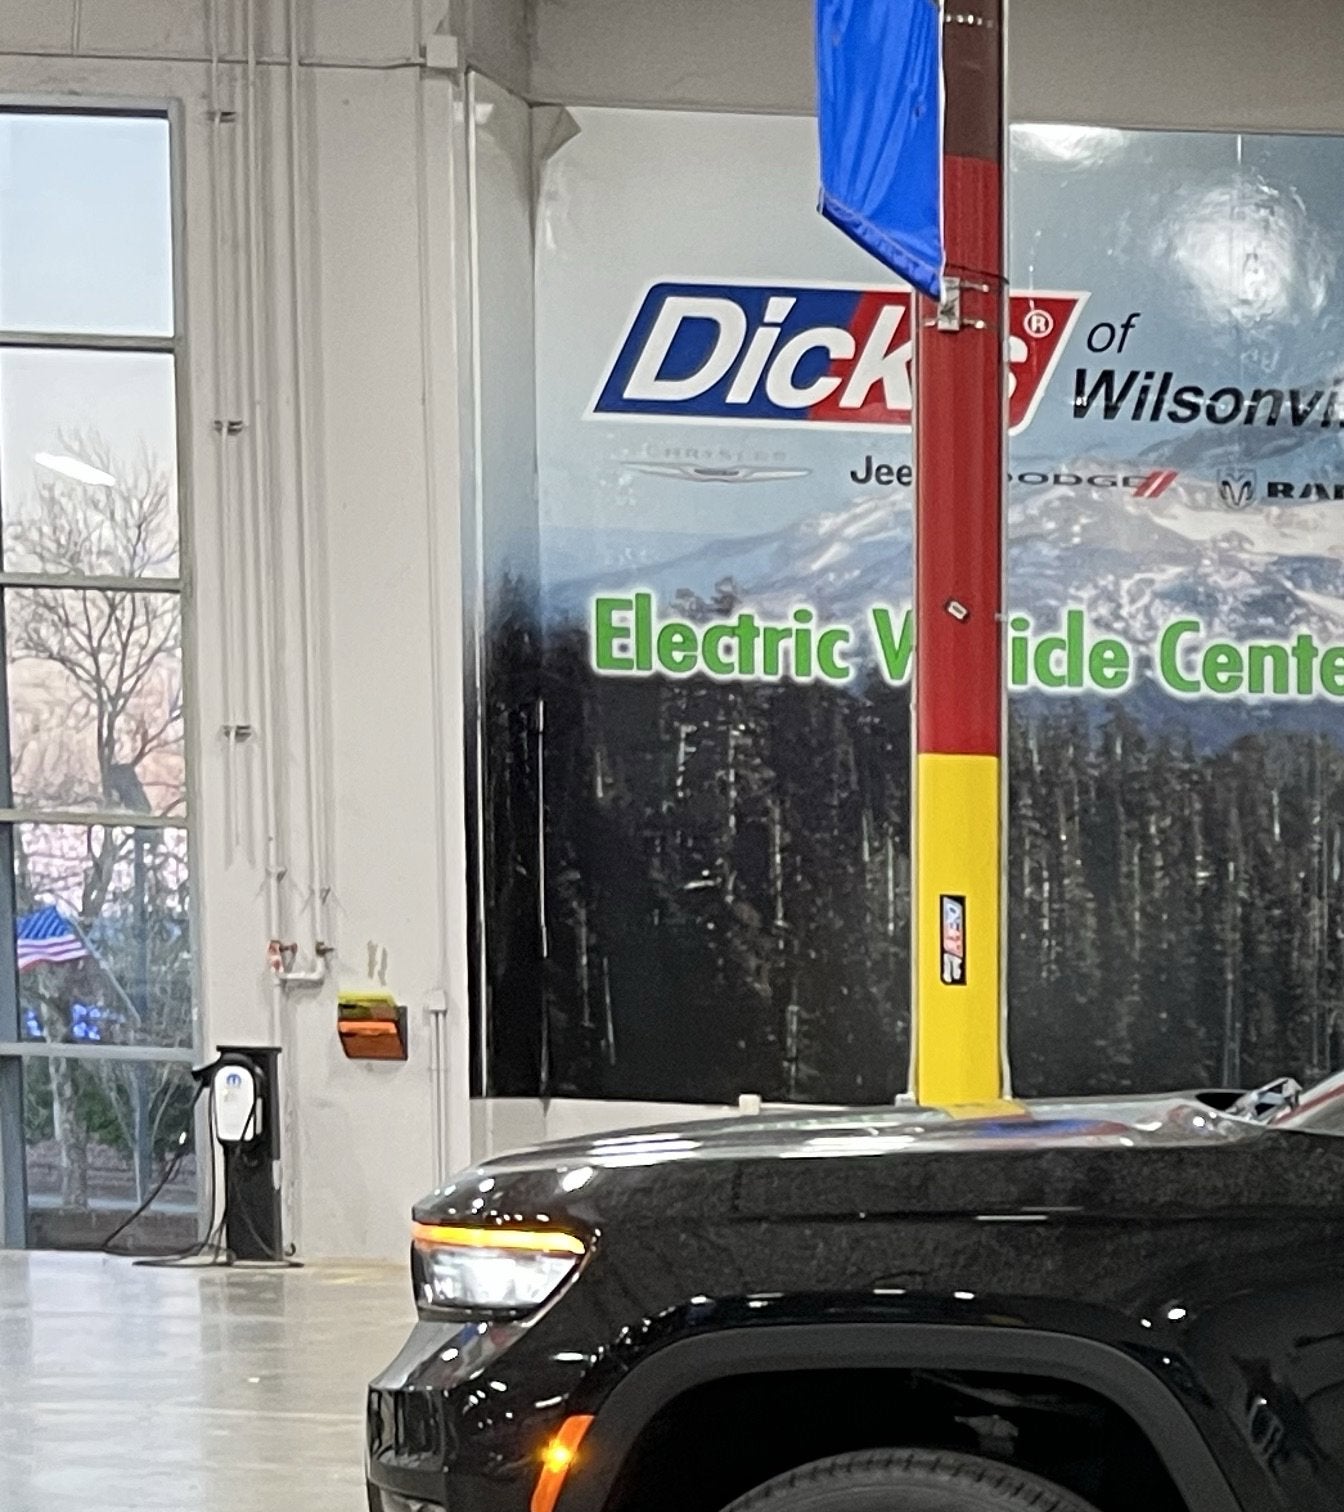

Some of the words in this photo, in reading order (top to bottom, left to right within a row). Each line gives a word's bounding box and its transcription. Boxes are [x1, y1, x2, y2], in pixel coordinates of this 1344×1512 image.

[1087, 313, 1141, 353] of
[850, 455, 912, 486] Jee
[1008, 472, 1150, 487] ODGE
[595, 592, 850, 680] Electric
[872, 607, 1130, 690] Vicle
